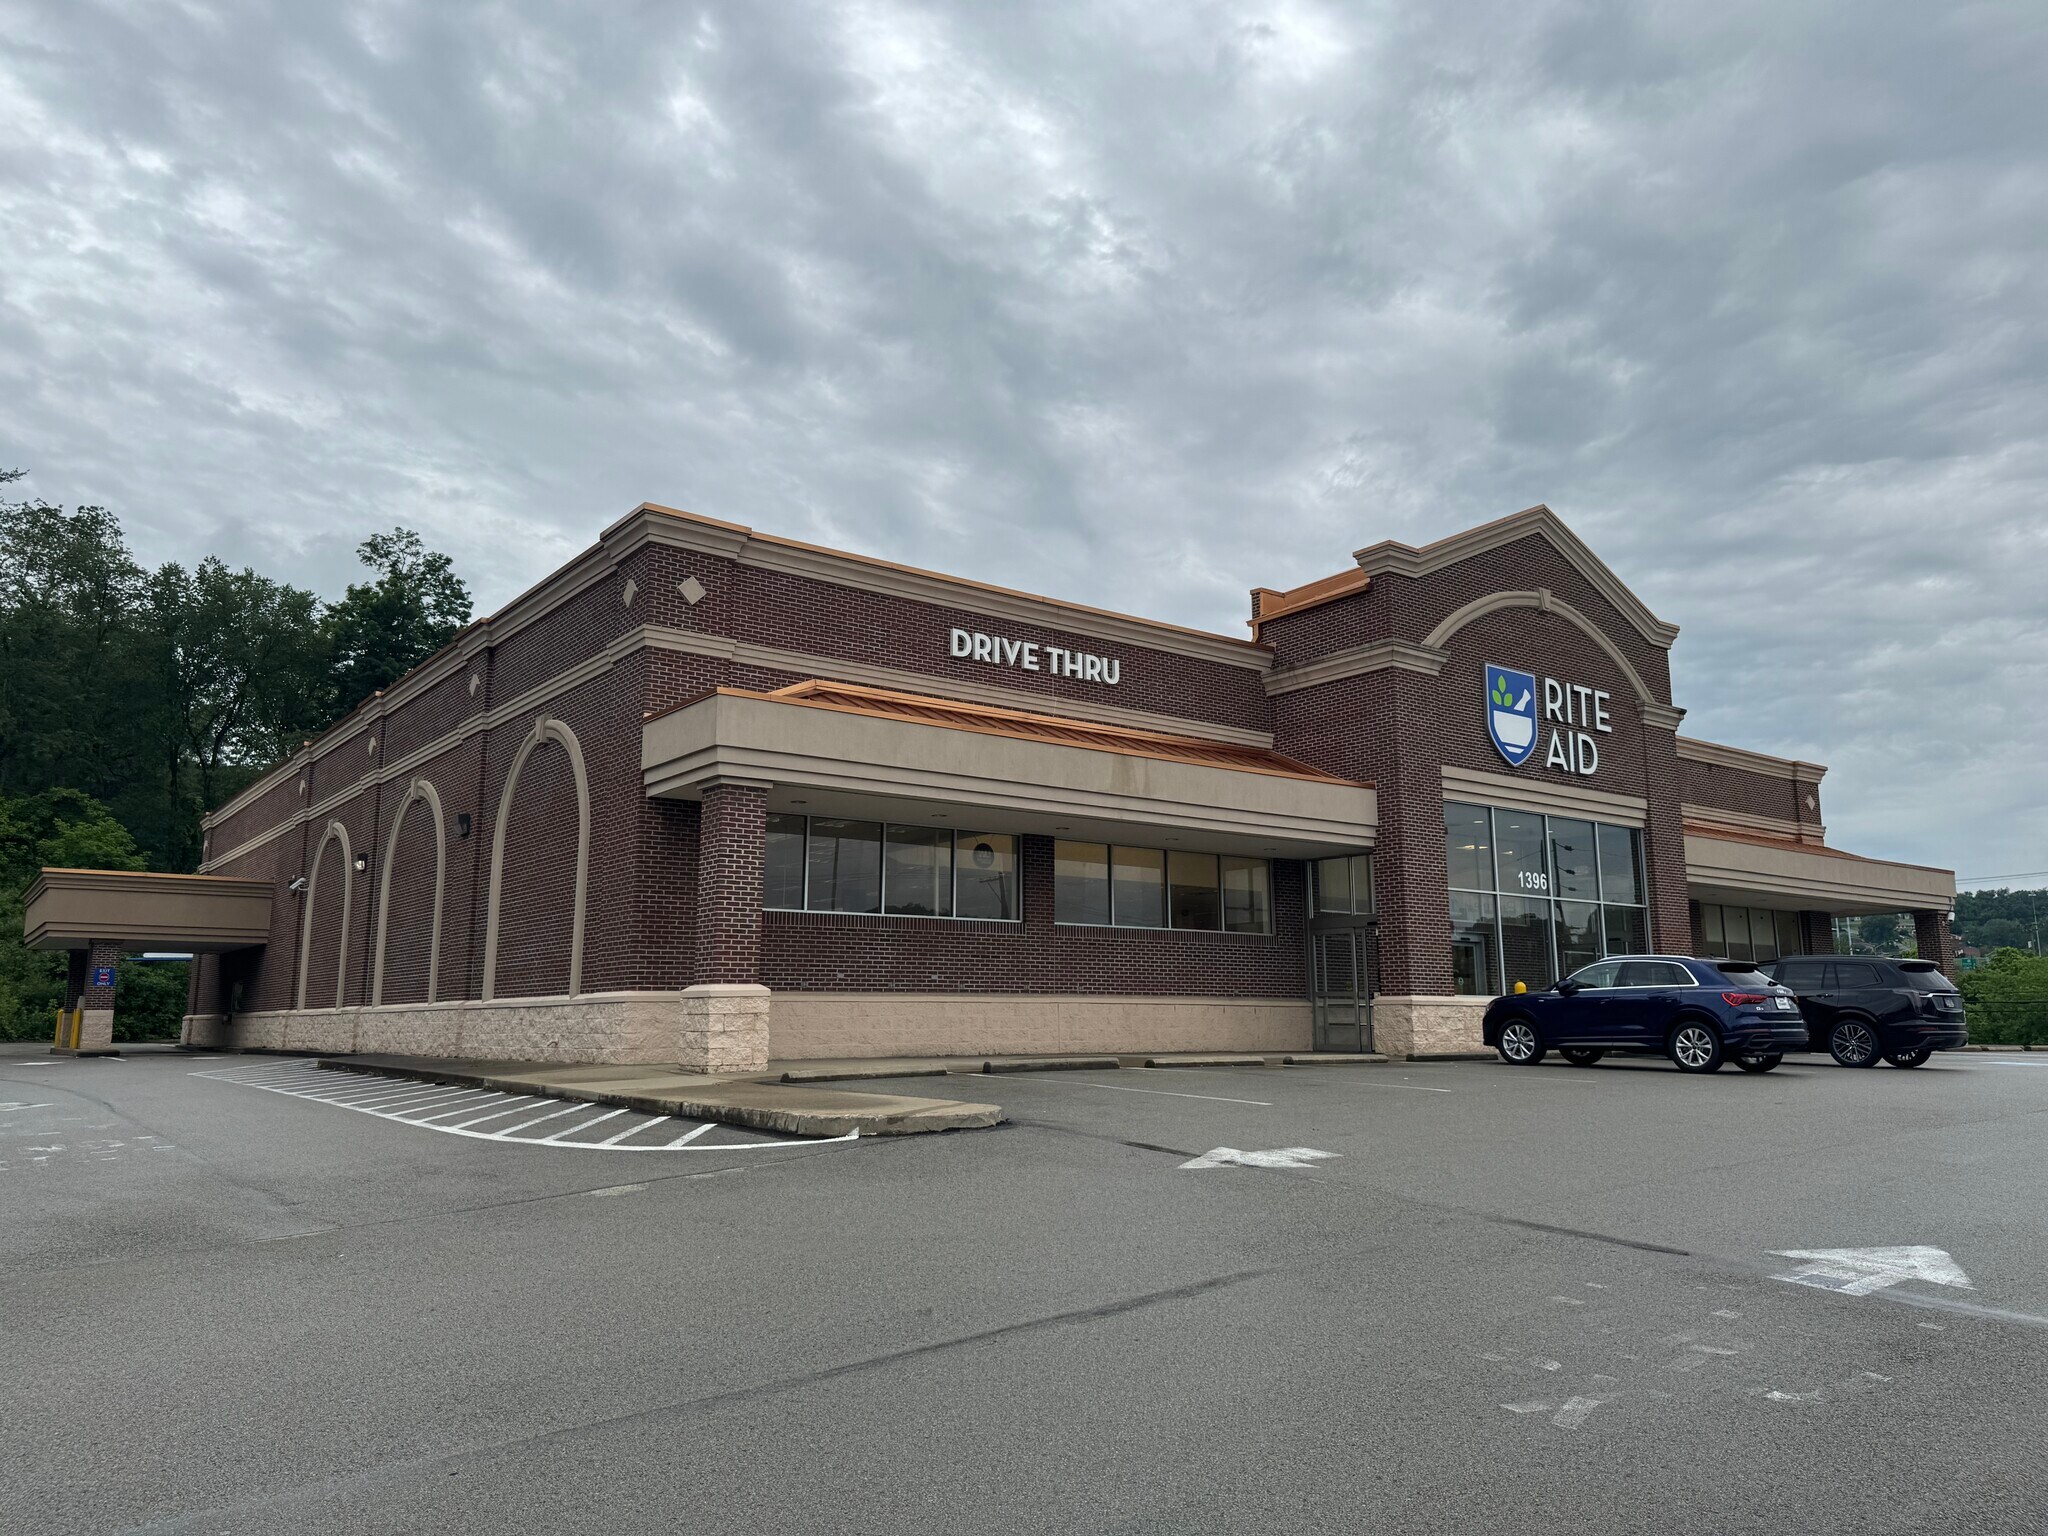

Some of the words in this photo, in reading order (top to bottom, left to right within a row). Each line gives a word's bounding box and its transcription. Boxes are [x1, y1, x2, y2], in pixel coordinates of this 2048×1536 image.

[950, 627, 1040, 672] DRIVE
[1044, 646, 1120, 686] THRU
[1543, 677, 1612, 733] RITE
[1544, 727, 1599, 776] AID
[1518, 870, 1548, 890] 1396
